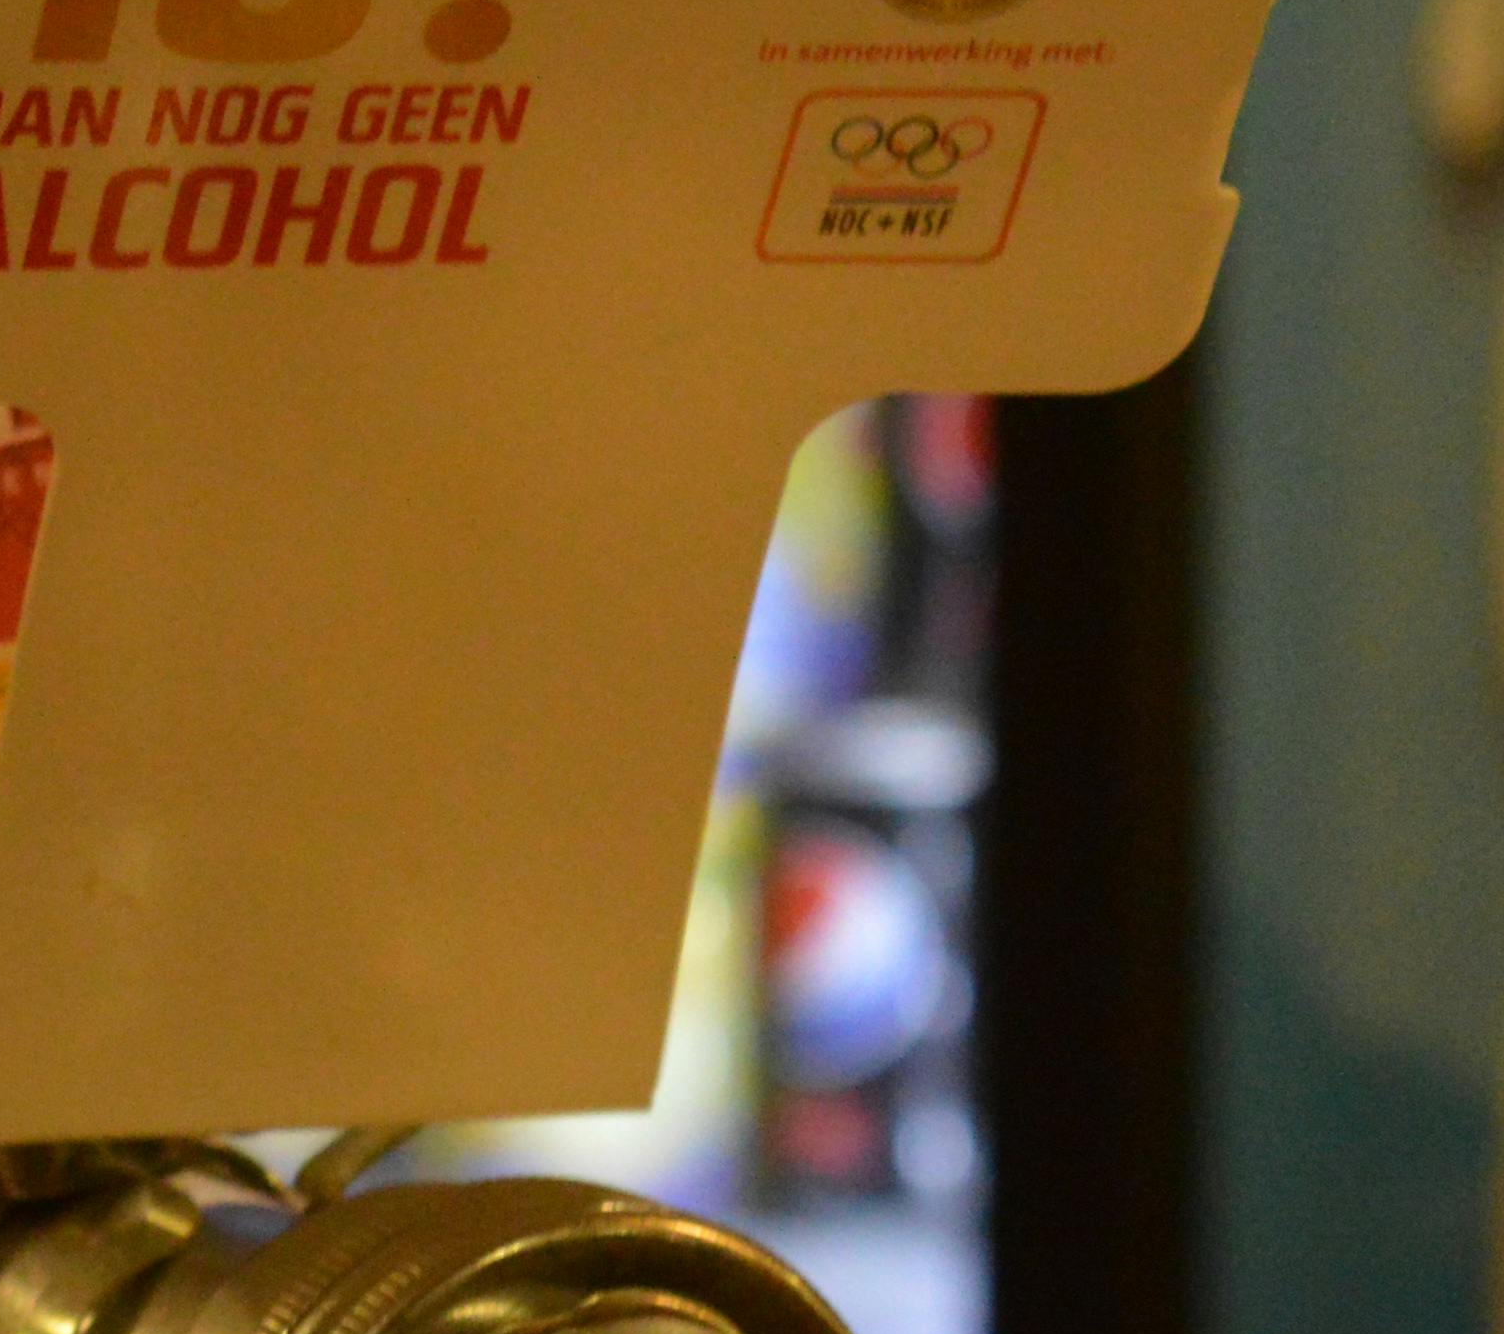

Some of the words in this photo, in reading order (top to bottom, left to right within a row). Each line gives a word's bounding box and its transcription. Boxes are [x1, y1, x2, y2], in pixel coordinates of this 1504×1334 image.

[799, 36, 1033, 71] samenwerking
[146, 85, 316, 147] NOG
[336, 83, 532, 145] GEEN
